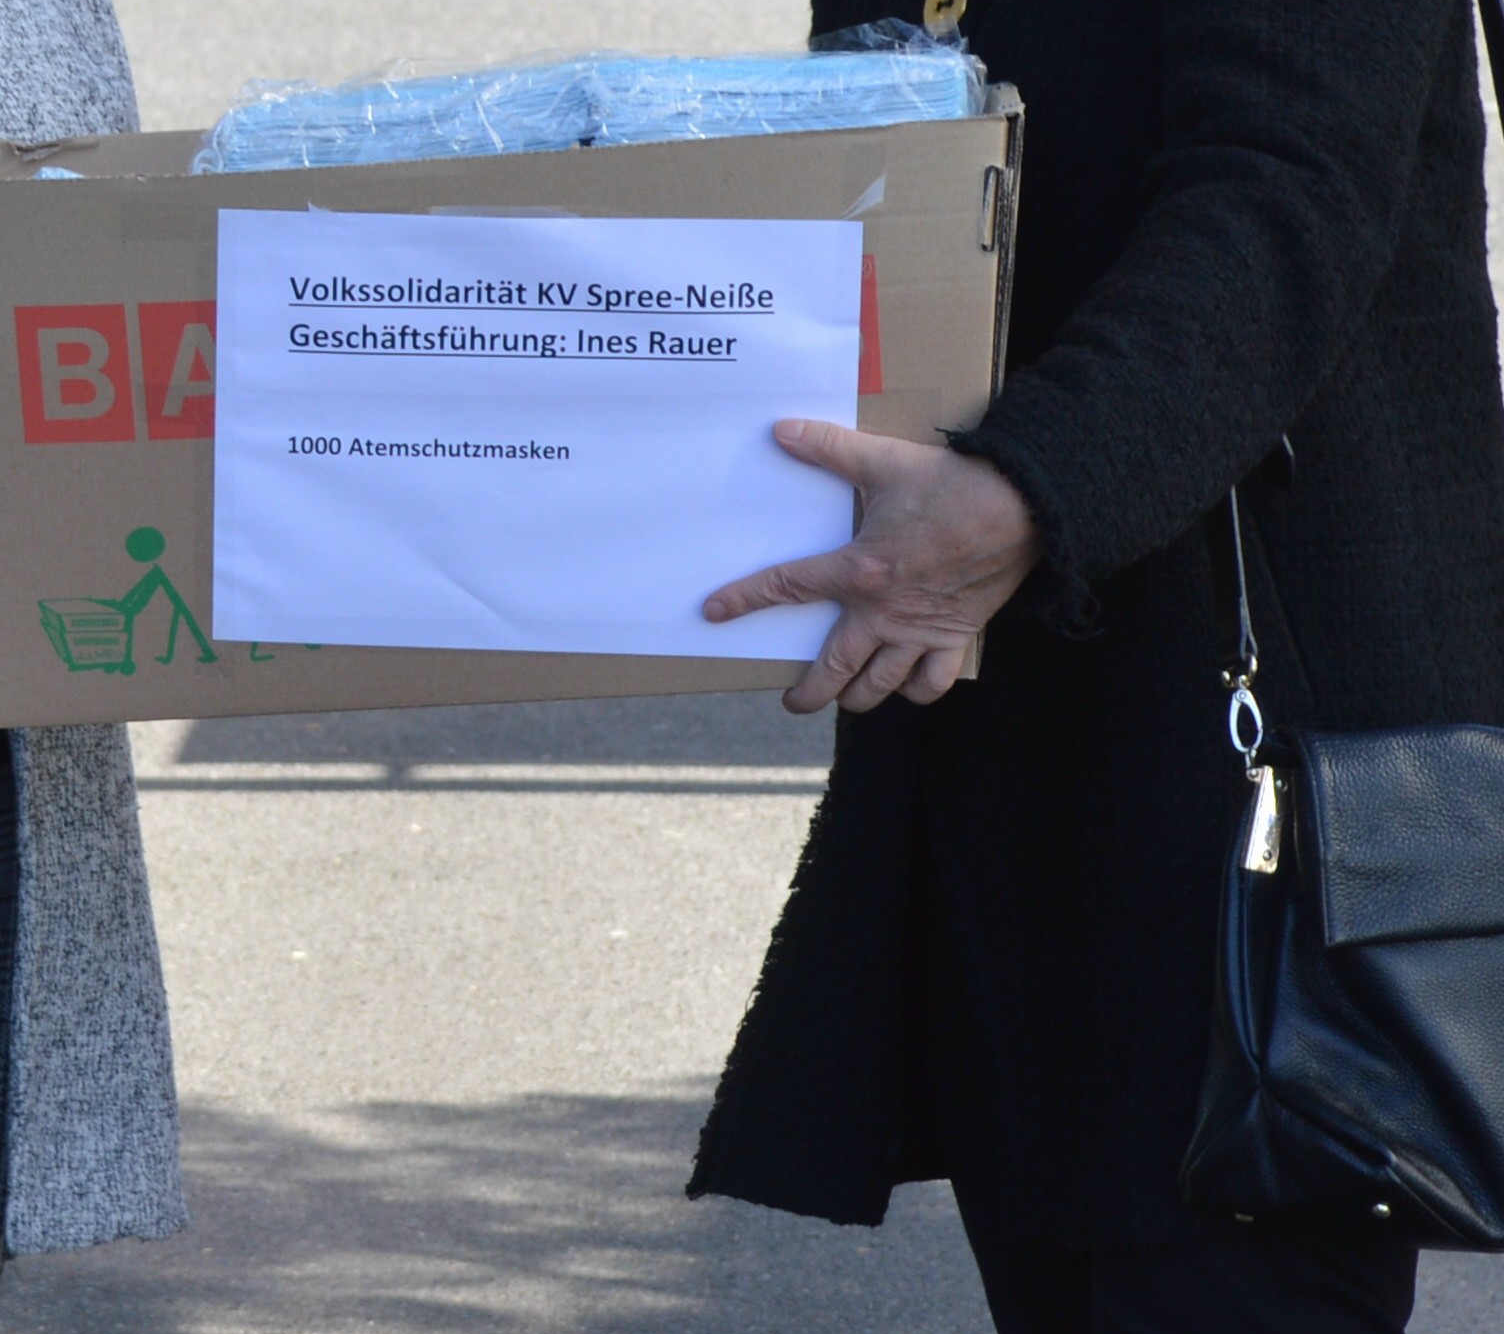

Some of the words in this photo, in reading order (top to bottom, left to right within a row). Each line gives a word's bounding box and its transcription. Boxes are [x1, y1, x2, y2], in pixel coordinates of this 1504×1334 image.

[289, 276, 528, 305] Volkssolidarität
[537, 282, 578, 306] KV
[586, 282, 774, 311] Spree-Neiße
[289, 323, 567, 357] Geschäftsführung:
[577, 329, 638, 354] Ines
[648, 330, 738, 355] Rauer
[288, 436, 342, 455] 1000
[348, 437, 570, 459] Atemschutzmasken
